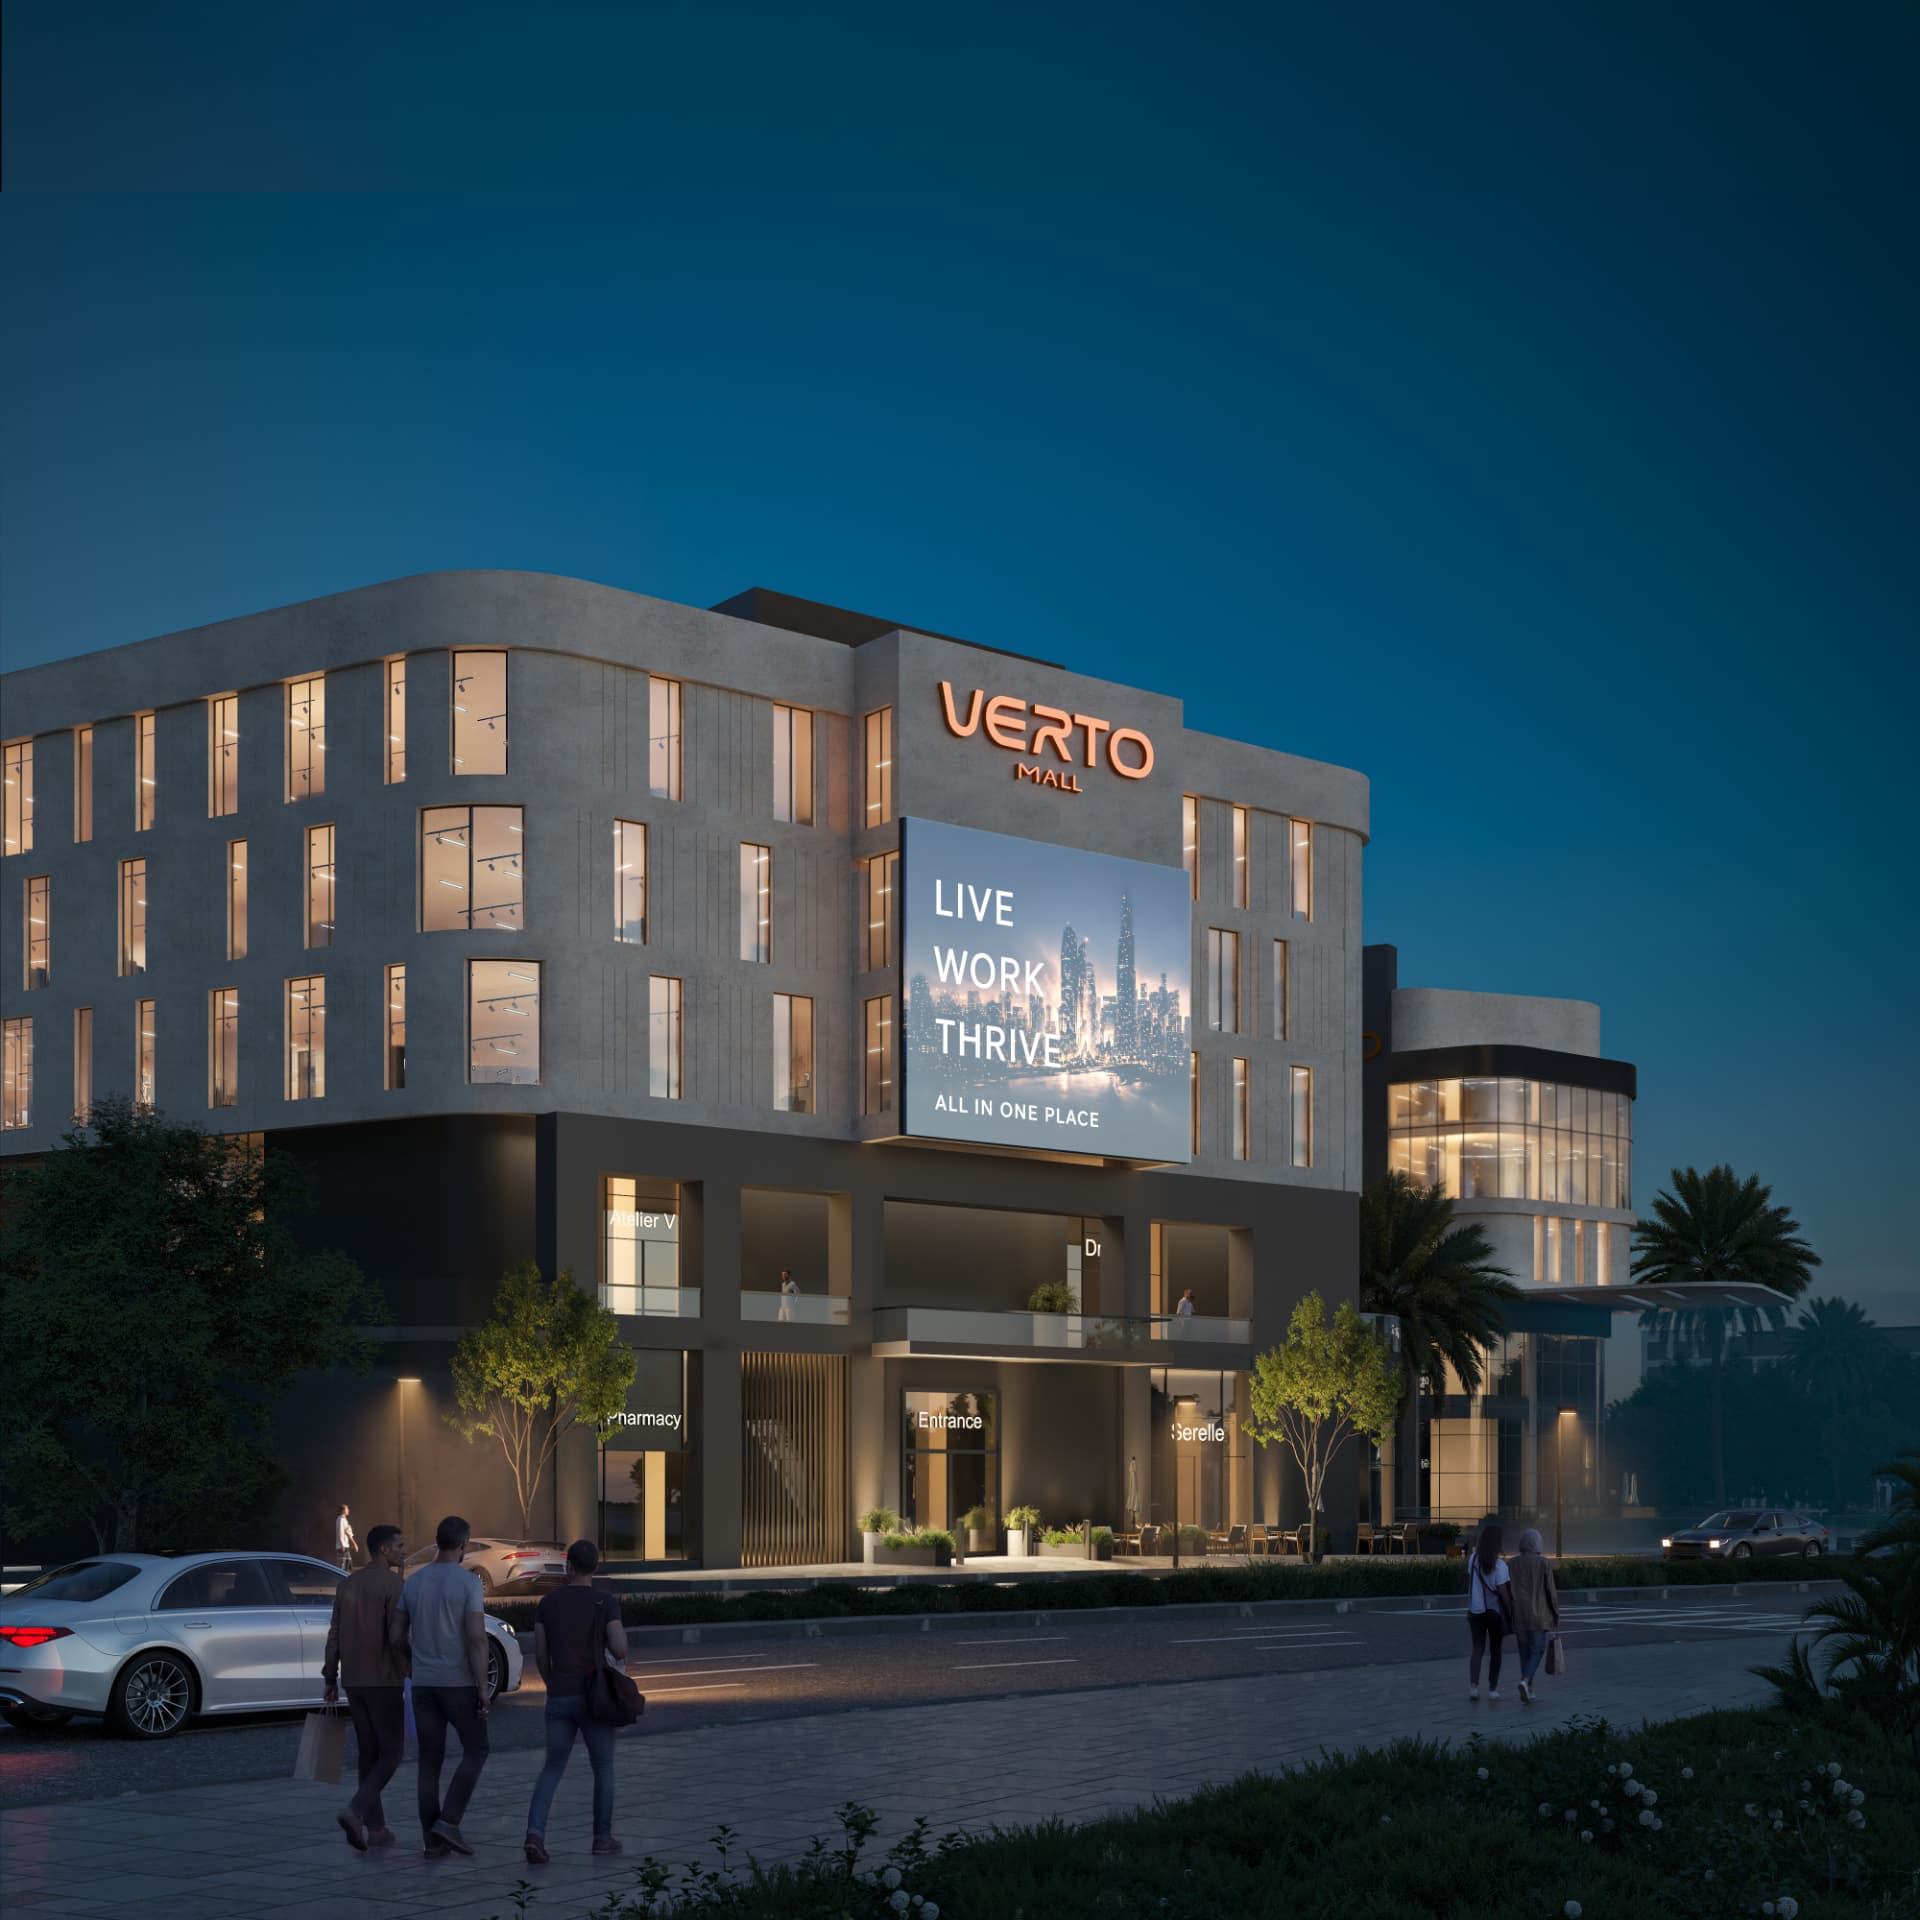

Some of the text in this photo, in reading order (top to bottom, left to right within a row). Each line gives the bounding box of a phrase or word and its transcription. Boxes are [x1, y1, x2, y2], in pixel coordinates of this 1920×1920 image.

[939, 680, 1155, 779] VERTO
[1015, 762, 1083, 793] MALL
[935, 879, 1014, 927] LIVE
[933, 945, 1045, 998] WORK
[935, 1018, 1062, 1068] THRIVE
[934, 1094, 1099, 1128] ALL IN ONE PLACE
[609, 1209, 676, 1230] Atelier V
[607, 1411, 682, 1431] Pharmacy
[918, 1411, 983, 1429] Entrance
[1171, 1423, 1225, 1442] Serelle
